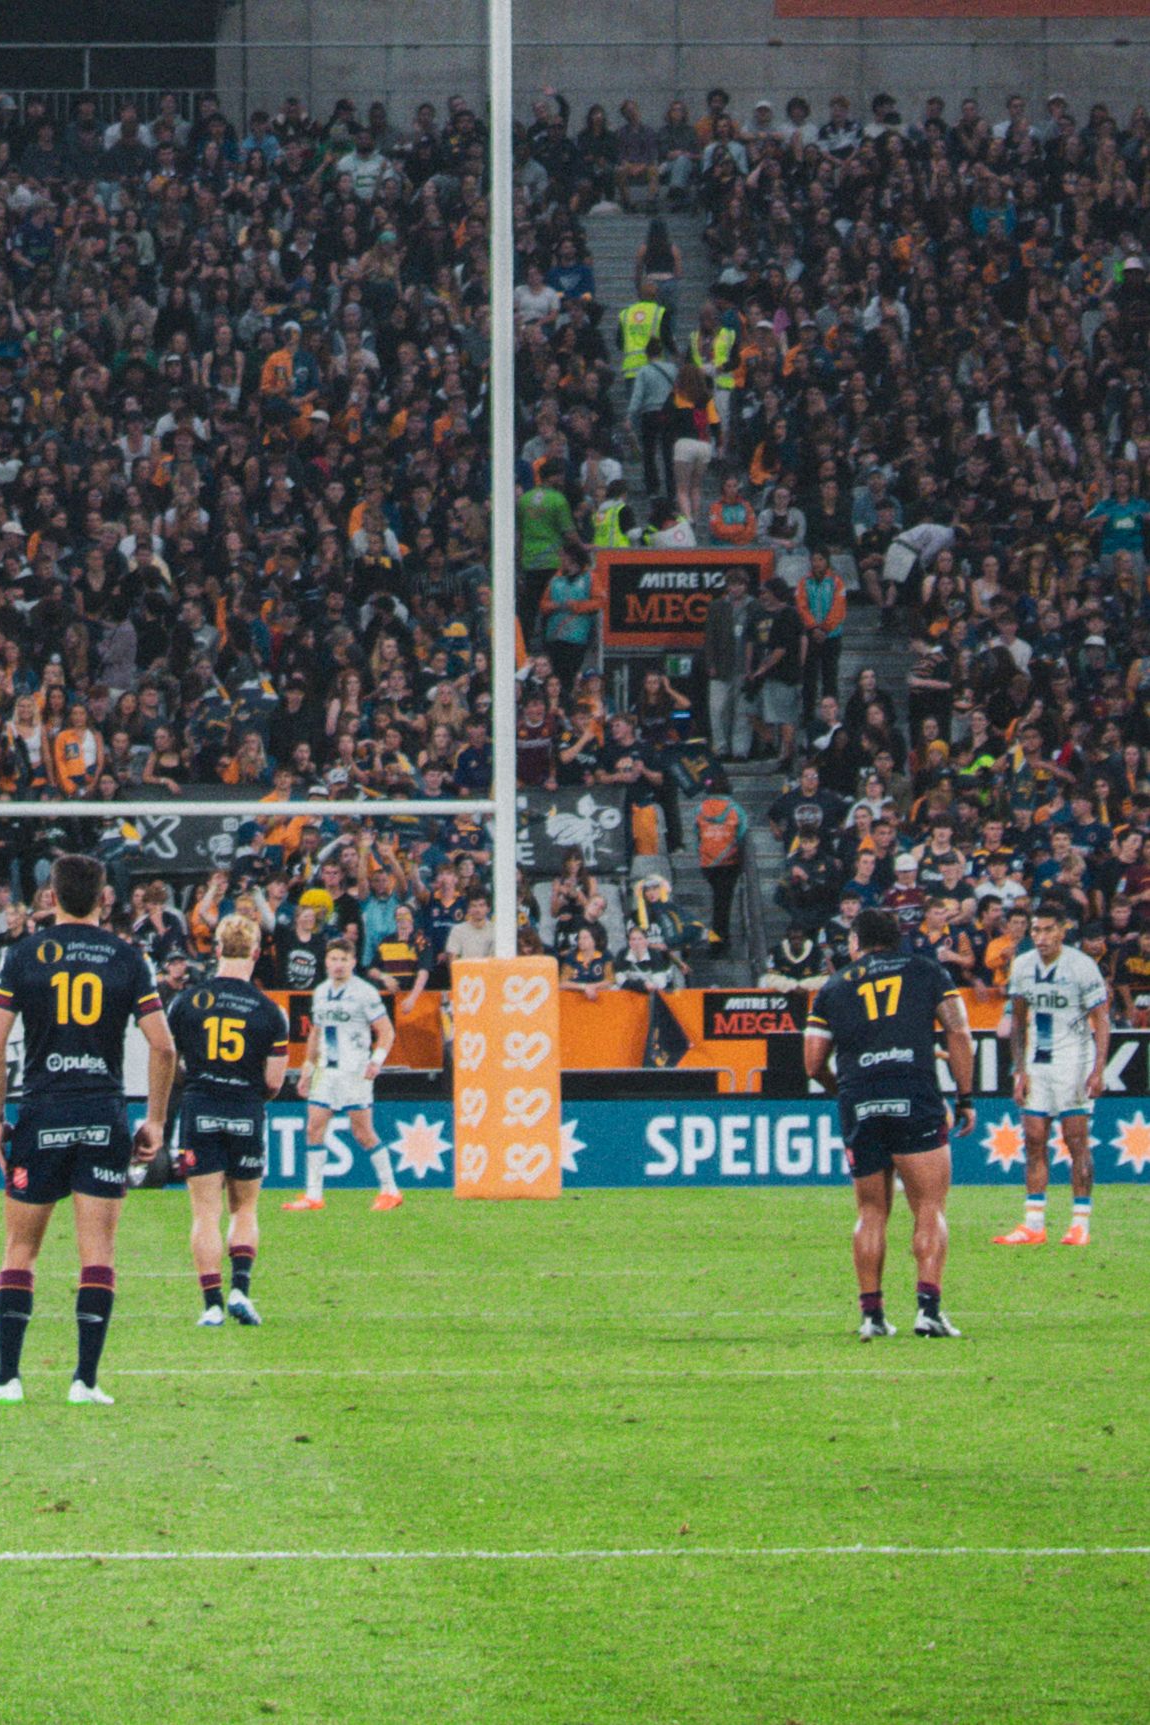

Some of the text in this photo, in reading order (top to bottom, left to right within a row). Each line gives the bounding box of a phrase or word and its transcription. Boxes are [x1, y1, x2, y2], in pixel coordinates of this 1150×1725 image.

[639, 572, 726, 588] MITRE 10
[625, 593, 713, 624] MEG
[51, 971, 103, 1026] 10
[725, 997, 788, 1010] MITRE 10
[857, 976, 903, 1021] 17
[1036, 990, 1069, 1009] nib
[714, 1013, 798, 1035] MEGA
[203, 1016, 246, 1062] 15
[64, 1053, 107, 1072] pulse
[874, 1047, 915, 1063] pulse
[645, 1115, 849, 1176] SPEIGH
